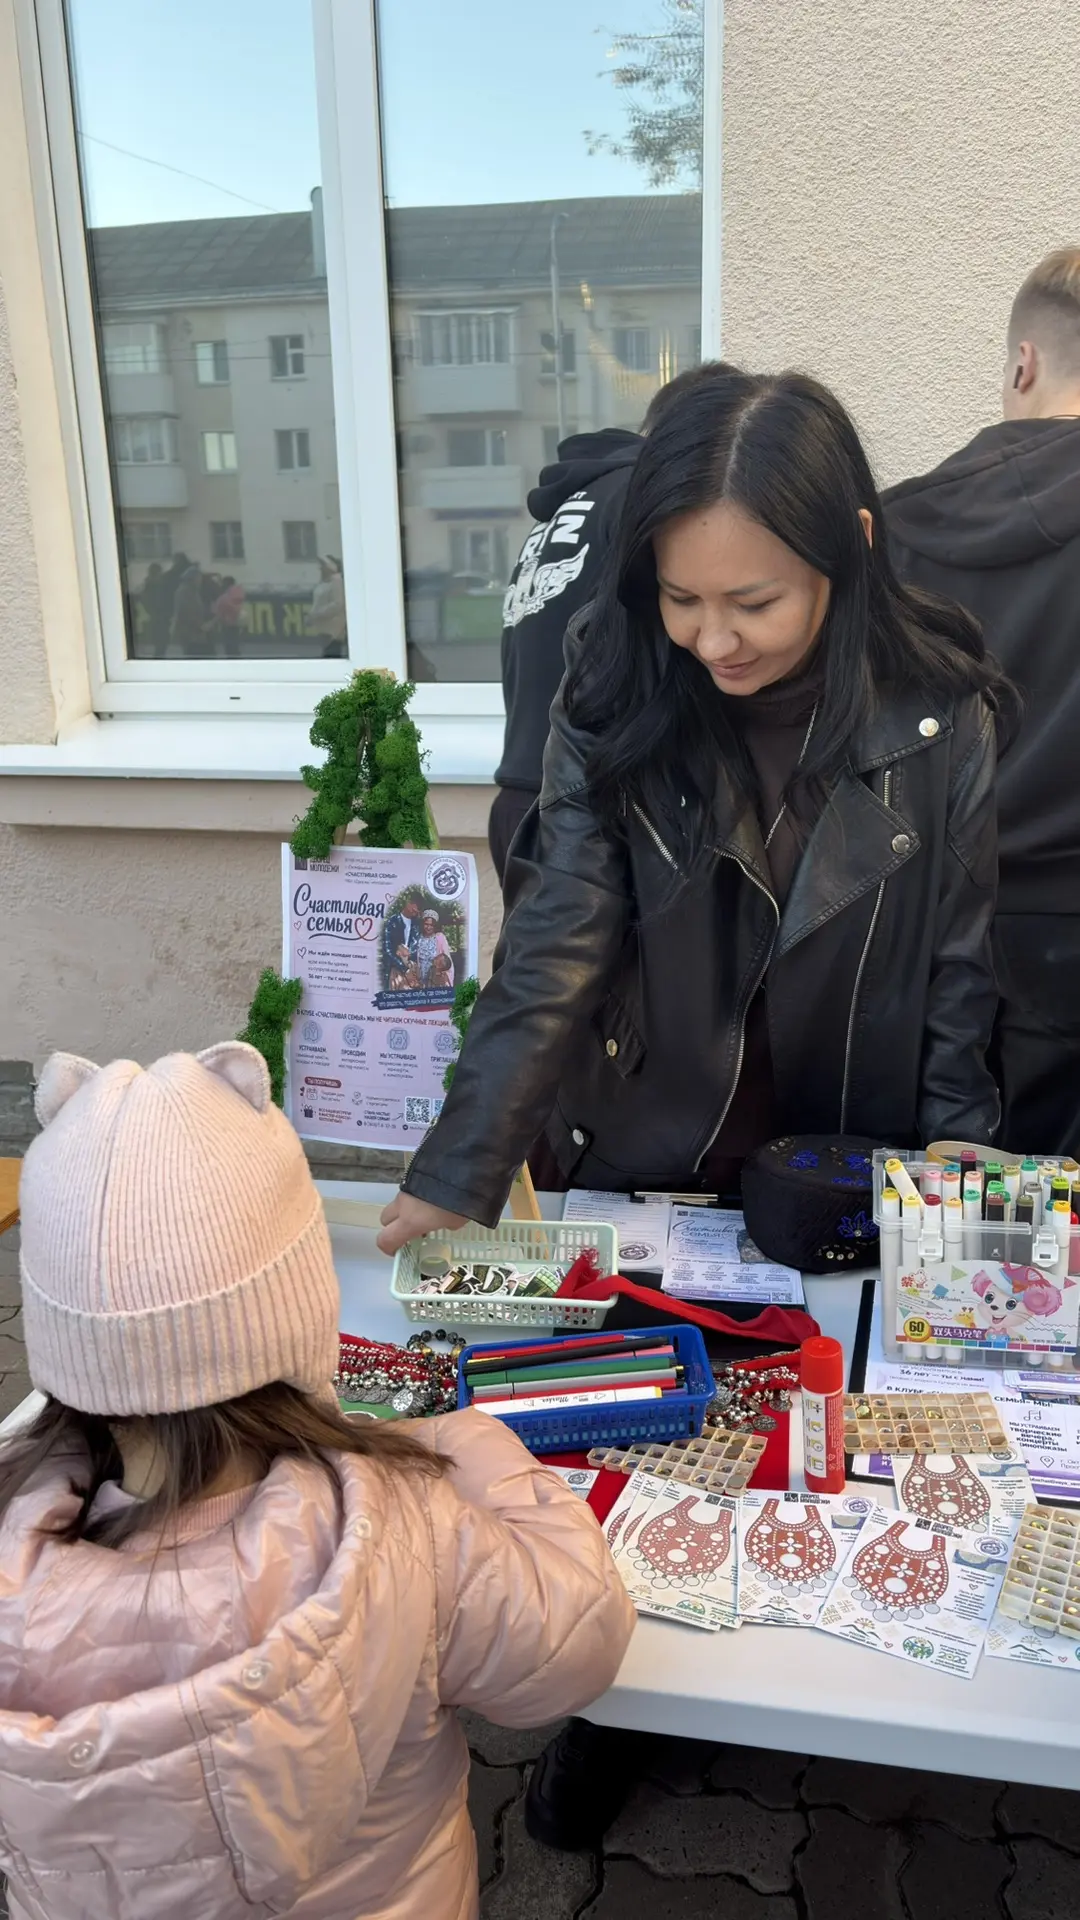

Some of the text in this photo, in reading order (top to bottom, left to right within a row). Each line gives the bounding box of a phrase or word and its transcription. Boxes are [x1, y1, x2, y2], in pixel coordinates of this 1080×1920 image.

[293, 883, 385, 918] Счастливая
[307, 916, 353, 933] семья
[909, 1321, 925, 1334] 60
[932, 1326, 983, 1339] 双头马克笔
[1009, 1426, 1062, 1438] творческие
[1020, 1423, 1061, 1432] УСТРАИВАЕМ
